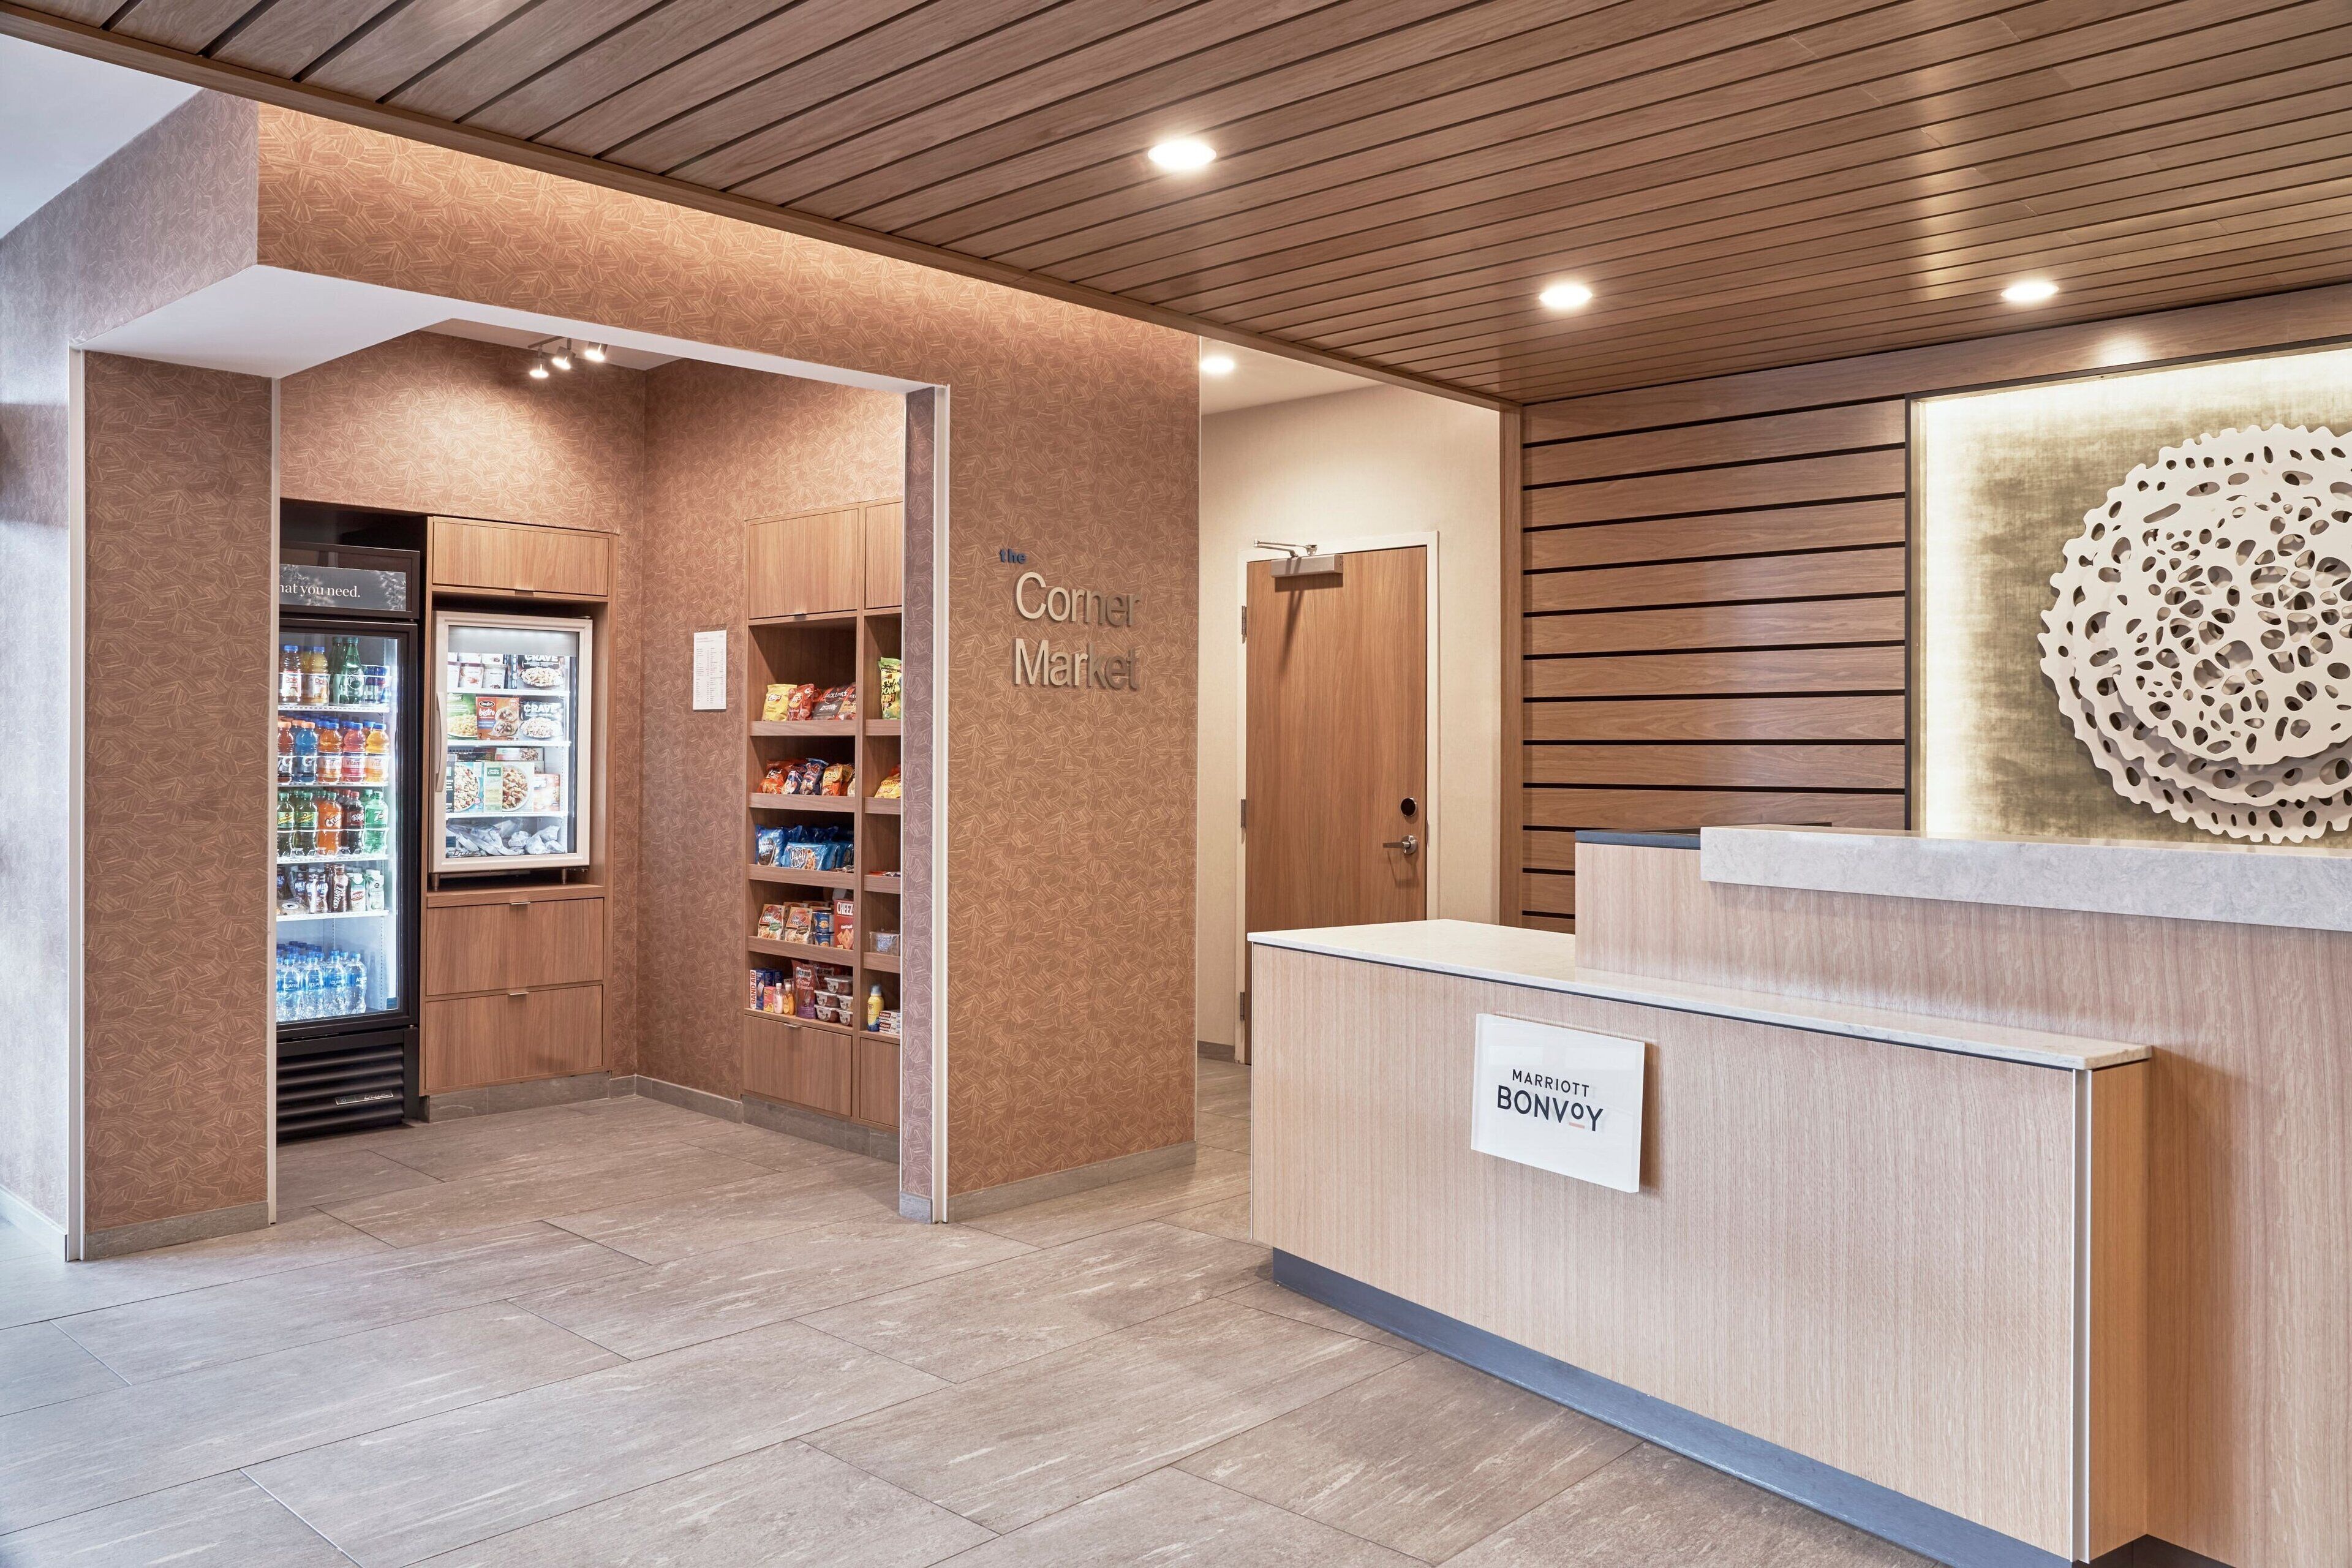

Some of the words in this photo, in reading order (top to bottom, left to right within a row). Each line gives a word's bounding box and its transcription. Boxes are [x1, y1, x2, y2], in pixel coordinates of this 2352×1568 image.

[999, 549, 1026, 564] the
[300, 586, 323, 597] you
[327, 586, 361, 598] need.
[1015, 571, 1142, 627] Corner
[1014, 638, 1139, 691] Market
[478, 708, 496, 717] bistro
[523, 704, 559, 713] CRAVE
[1512, 1069, 1589, 1097] MARRIOTT
[1497, 1085, 1604, 1132] BONVOY
